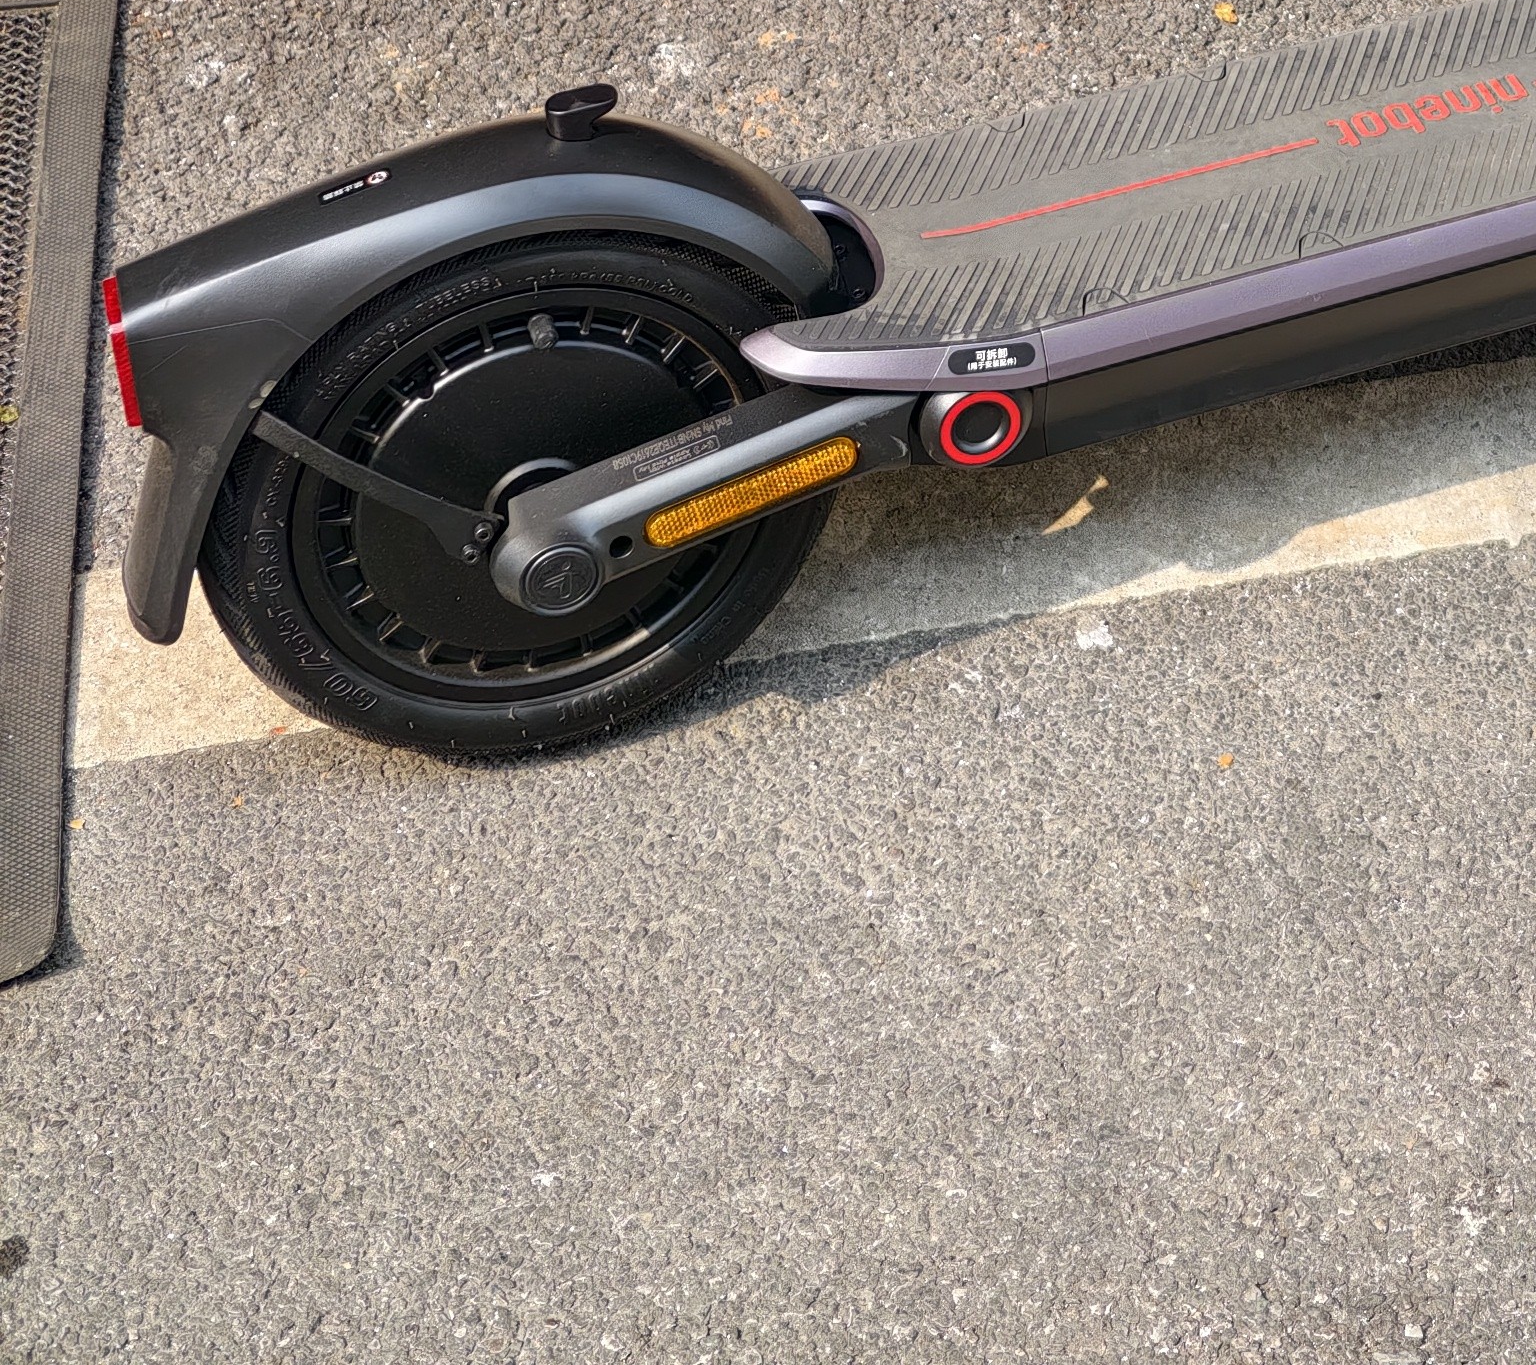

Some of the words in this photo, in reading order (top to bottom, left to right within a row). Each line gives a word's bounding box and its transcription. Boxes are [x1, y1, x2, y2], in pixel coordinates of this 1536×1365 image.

[1327, 72, 1529, 147] ninebot
[975, 348, 1008, 361] 可拆卸
